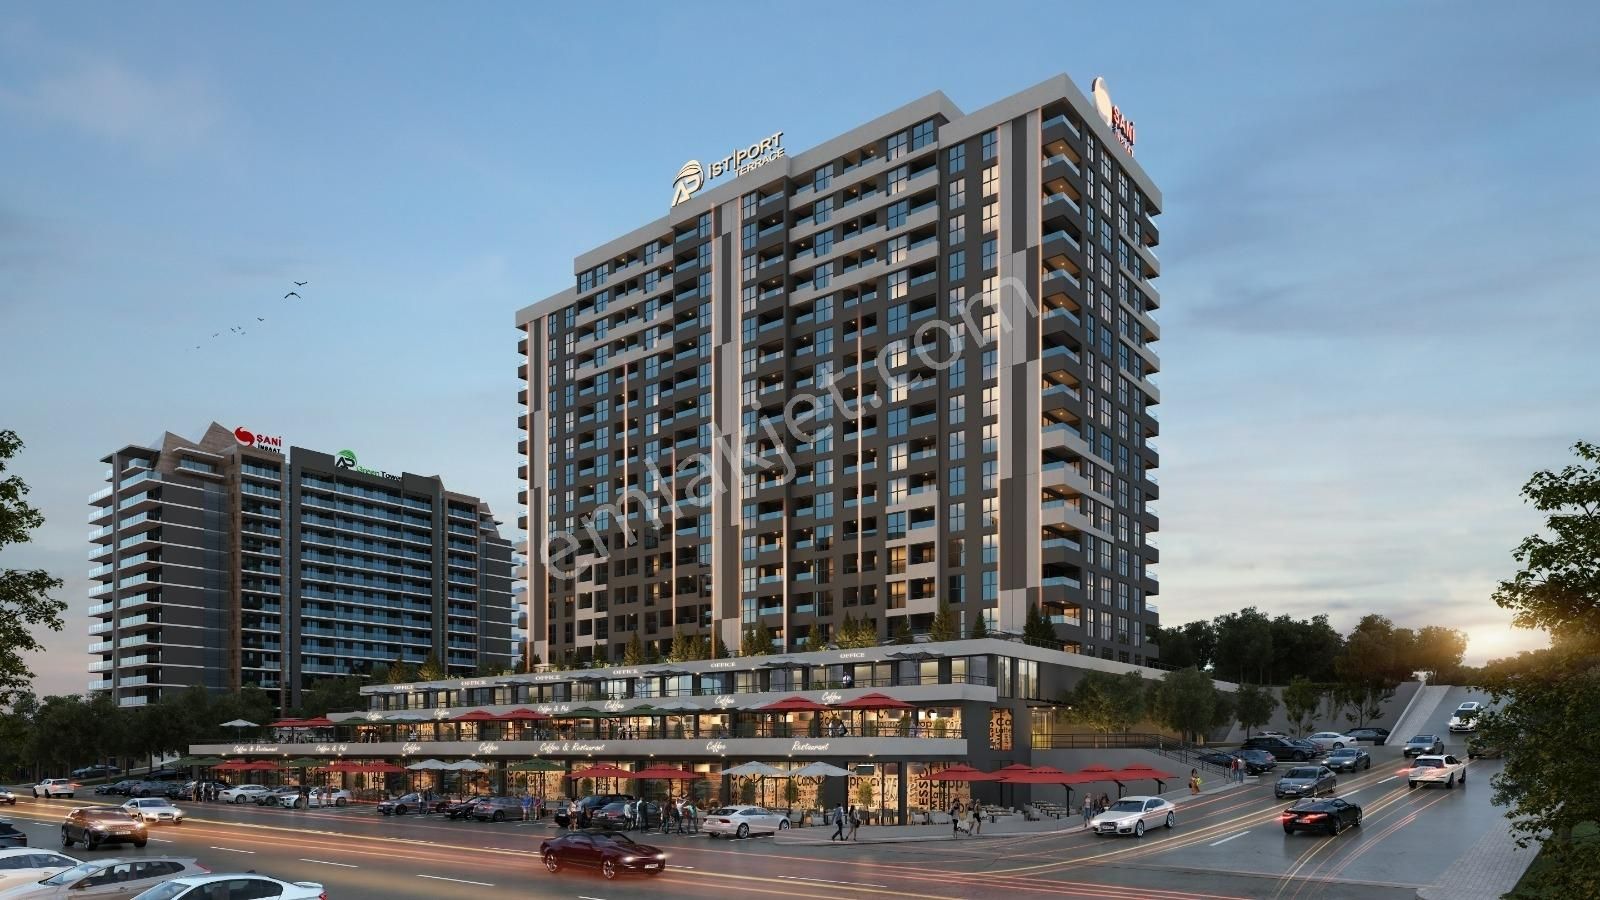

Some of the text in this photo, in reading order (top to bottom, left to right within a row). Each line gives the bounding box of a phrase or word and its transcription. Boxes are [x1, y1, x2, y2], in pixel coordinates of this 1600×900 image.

[735, 147, 785, 177] TERRACE
[714, 695, 735, 706] Coffee
[821, 692, 842, 703] Coffee
[604, 700, 624, 712] Coffee
[402, 742, 421, 754] Coffee
[478, 742, 499, 754] Coffee
[539, 742, 560, 754] Coffee
[706, 741, 727, 753] Coffee
[791, 740, 829, 751] Restaurant
